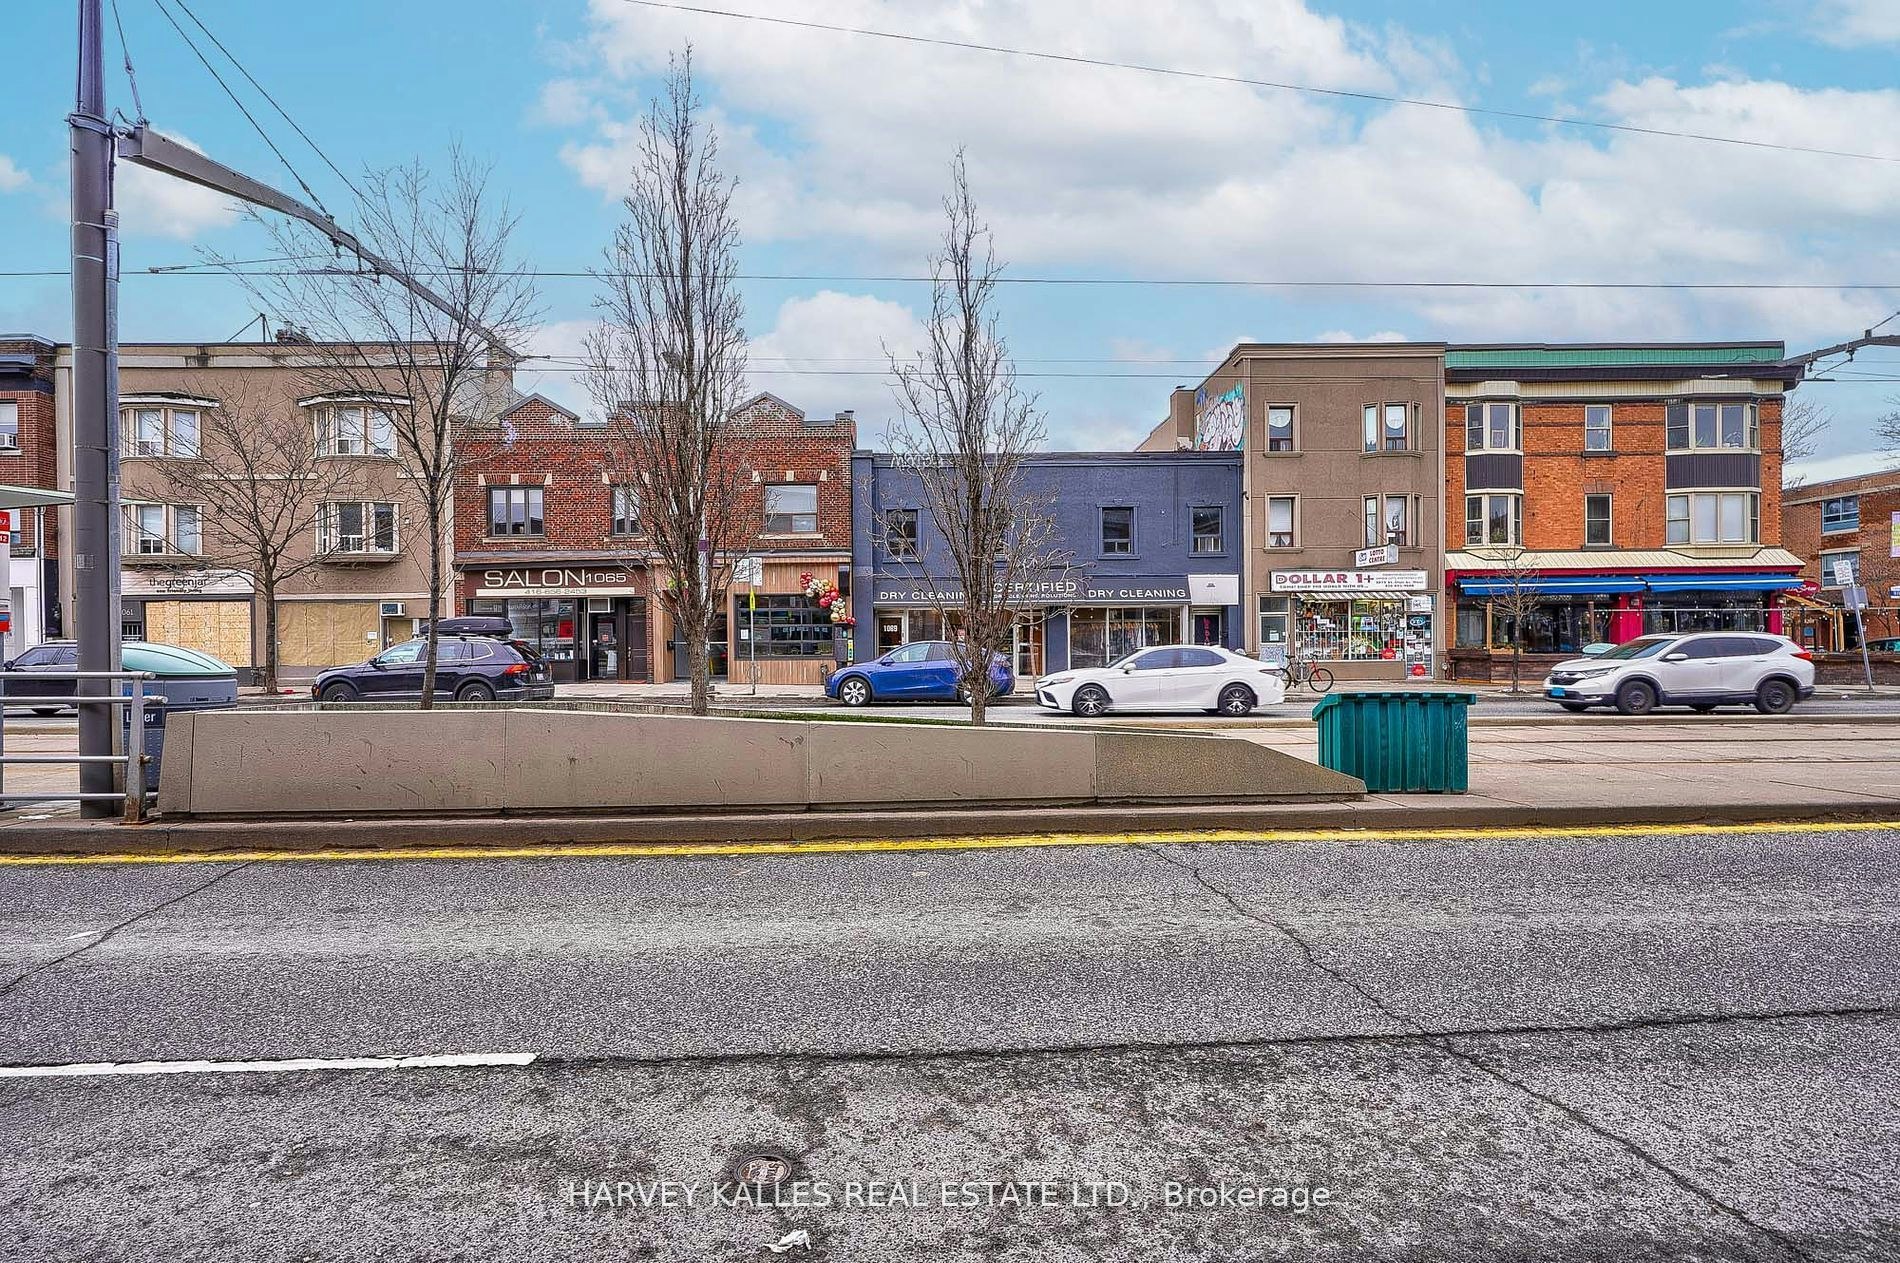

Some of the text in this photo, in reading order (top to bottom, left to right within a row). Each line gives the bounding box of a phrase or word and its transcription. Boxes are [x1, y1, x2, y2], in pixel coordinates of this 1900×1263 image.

[1369, 548, 1384, 557] LOTTO
[484, 569, 627, 588] SALON 1065
[1275, 573, 1348, 585] DOLLAR
[880, 592, 965, 600] DRY CLEANIN
[1088, 588, 1186, 598] DRY CLEANING
[125, 711, 156, 722] Ler
